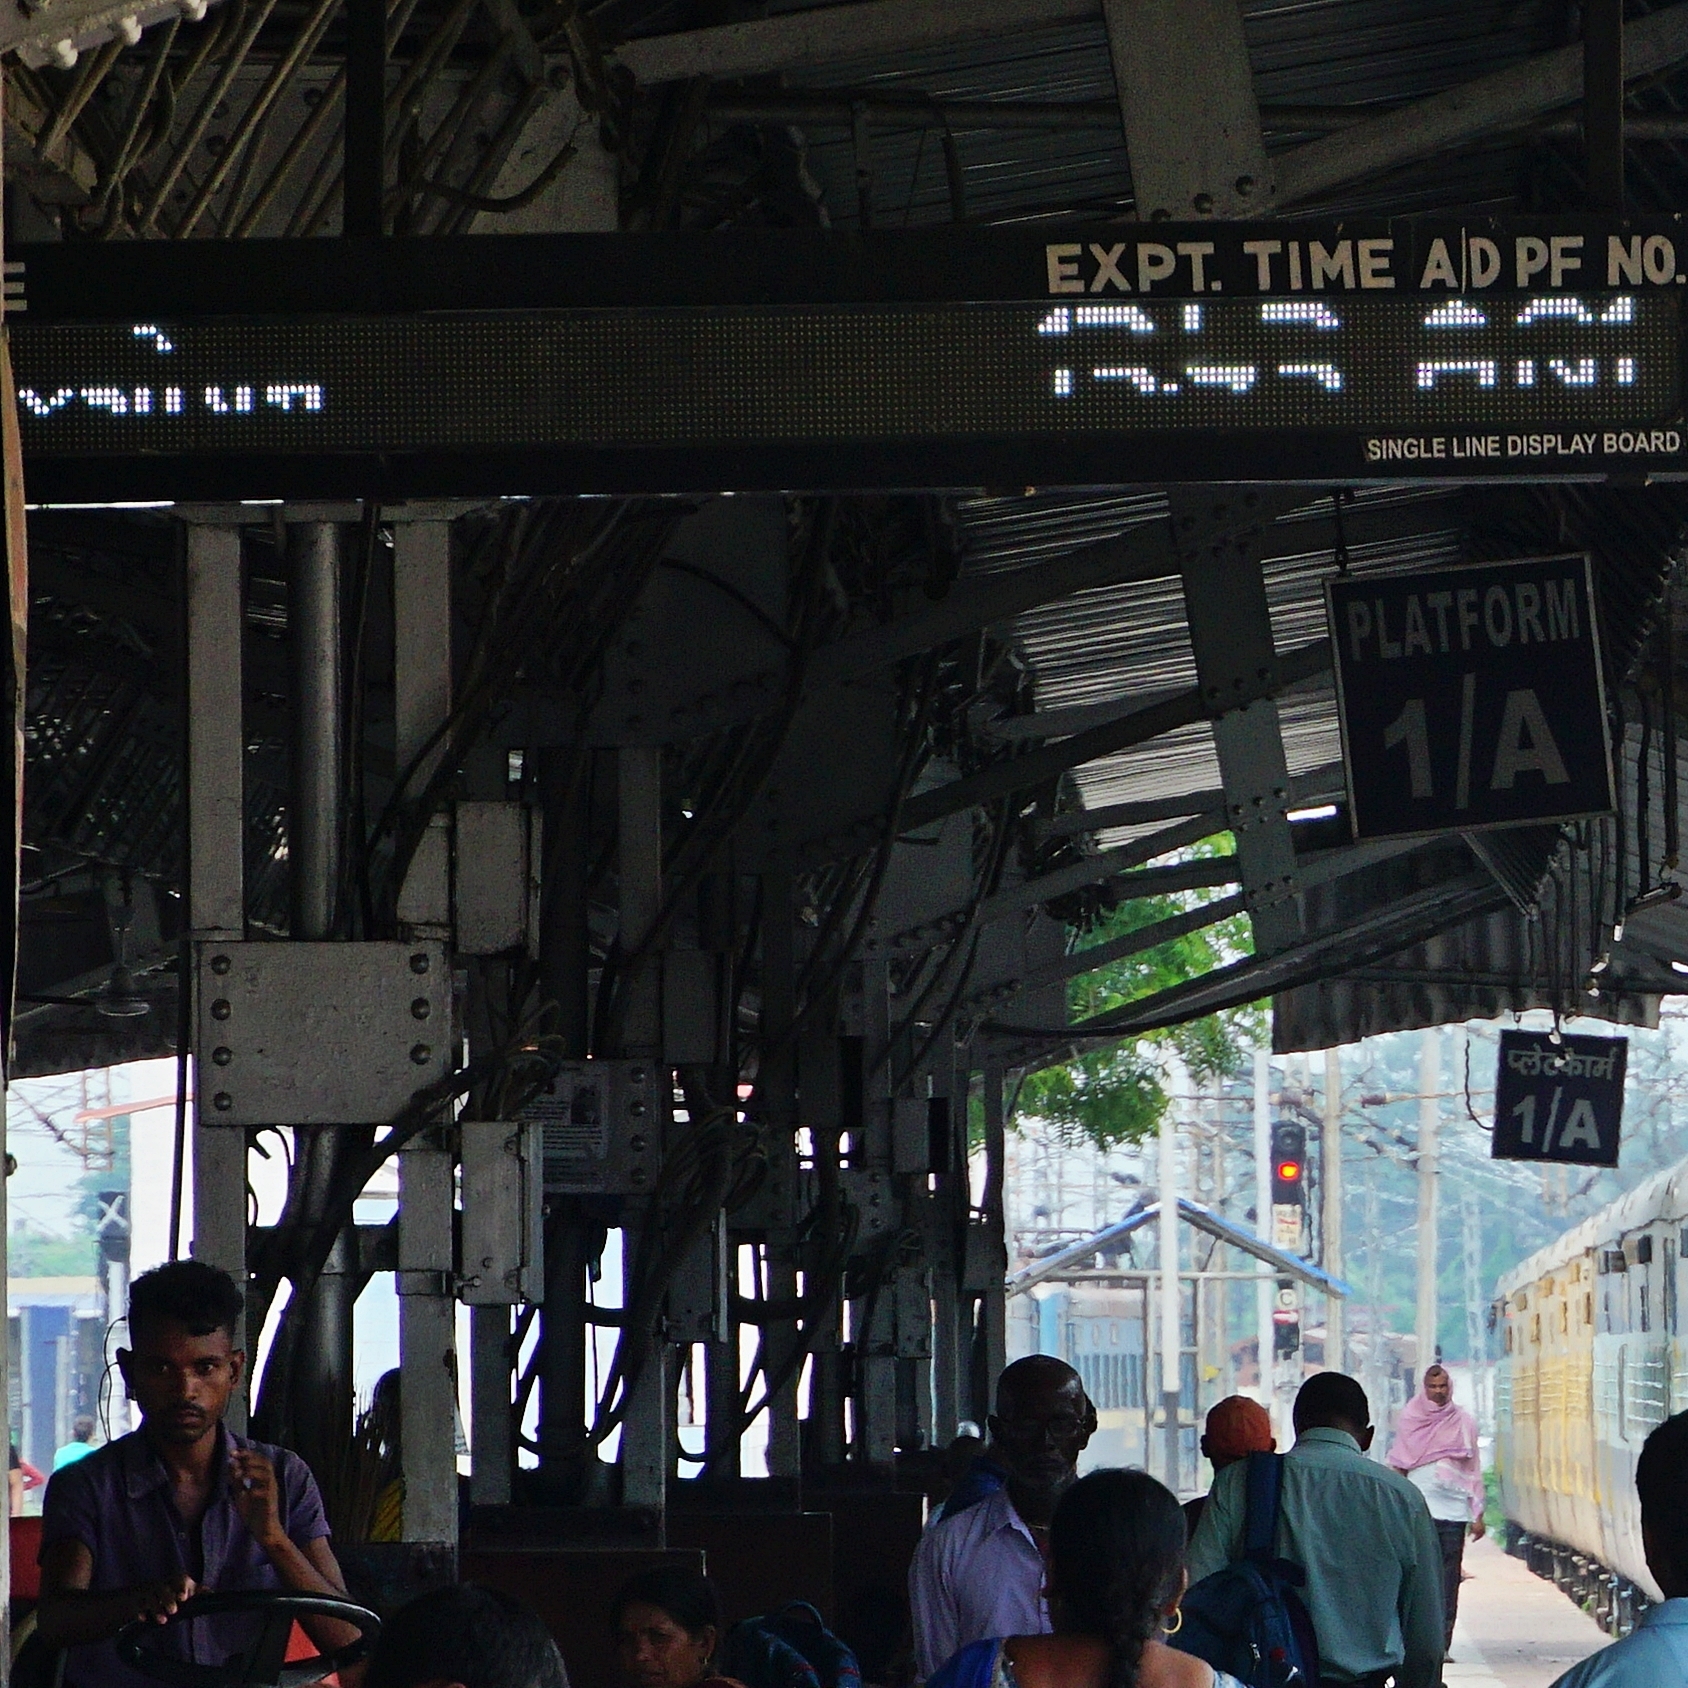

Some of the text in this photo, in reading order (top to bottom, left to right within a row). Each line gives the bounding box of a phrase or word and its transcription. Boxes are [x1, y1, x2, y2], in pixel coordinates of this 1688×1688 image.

[1046, 242, 1223, 294] EXPT.
[1243, 238, 1396, 291] TIME
[1515, 235, 1585, 288] PF
[1607, 234, 1688, 286] NO.
[1366, 430, 1681, 461] SINGLE LINE DISPLAY BOARD
[1349, 577, 1580, 662] PLATFORM
[1383, 671, 1572, 810] 1/A
[1511, 1085, 1601, 1153] 1/A
